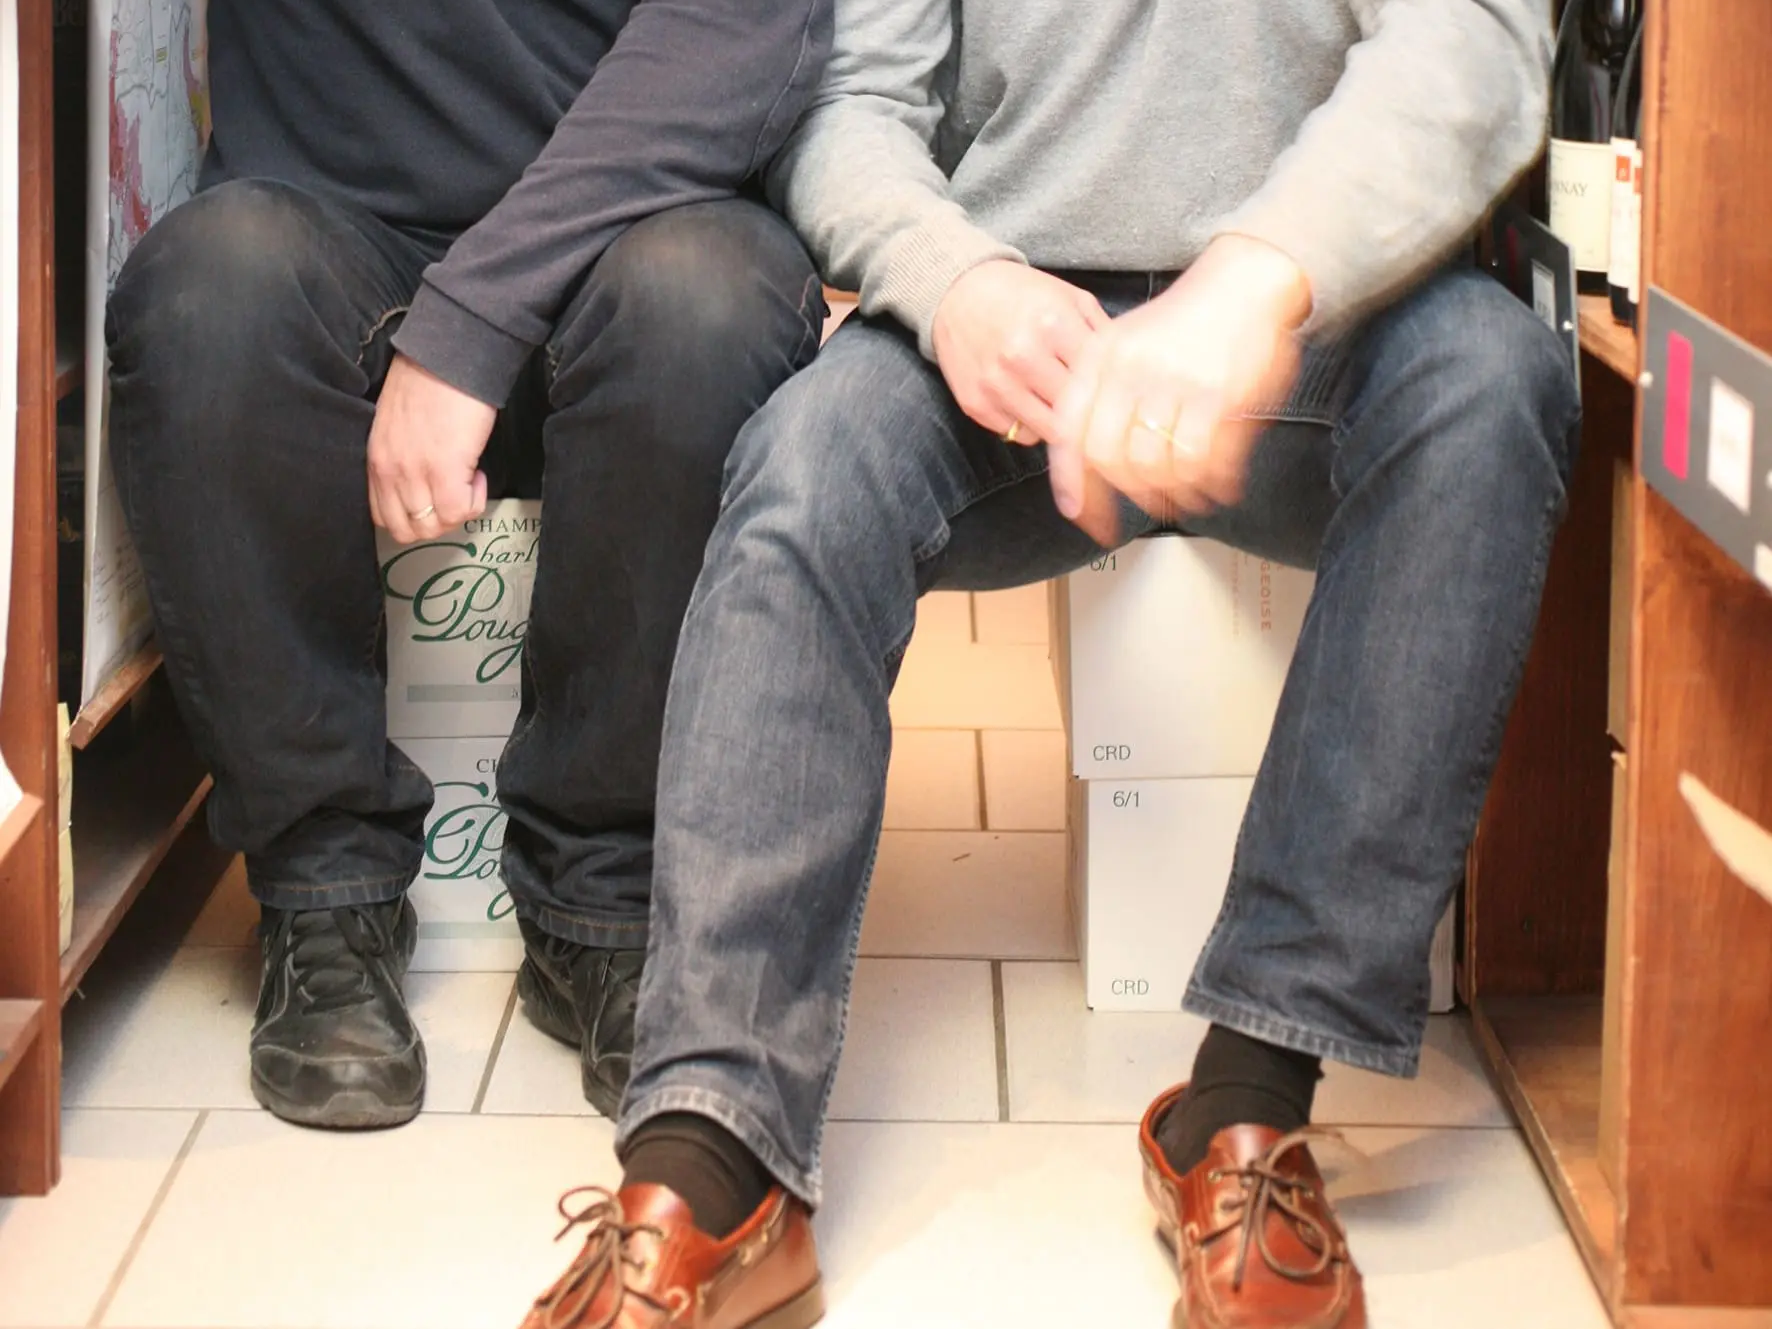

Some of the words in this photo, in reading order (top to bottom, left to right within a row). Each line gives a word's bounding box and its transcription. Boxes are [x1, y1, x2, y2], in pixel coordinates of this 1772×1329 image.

[464, 518, 542, 534] CHAMP
[1092, 744, 1132, 762] CRD
[1112, 789, 1142, 809] 6/1
[1111, 977, 1150, 997] CRD
